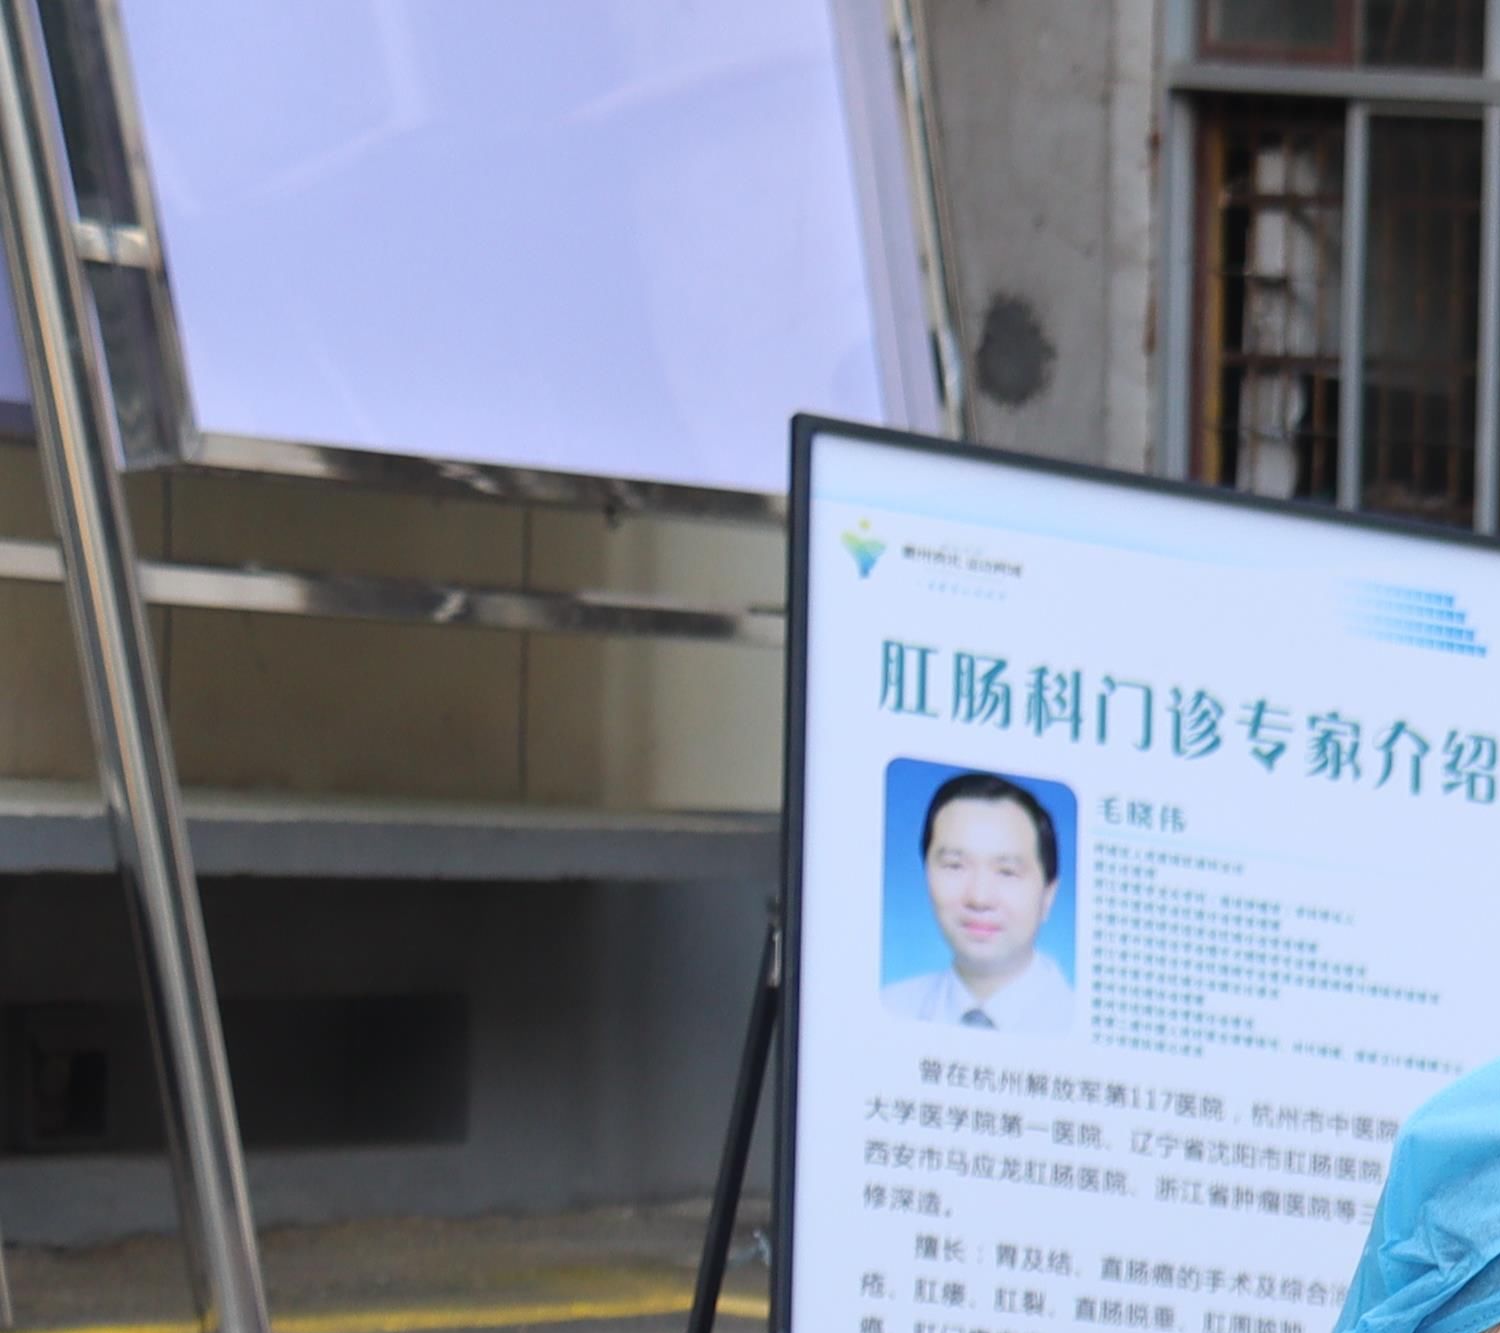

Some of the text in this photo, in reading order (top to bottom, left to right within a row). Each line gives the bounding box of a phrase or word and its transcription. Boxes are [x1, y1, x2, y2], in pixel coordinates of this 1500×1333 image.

[878, 638, 1500, 806] 肛肠科门诊专家介绍
